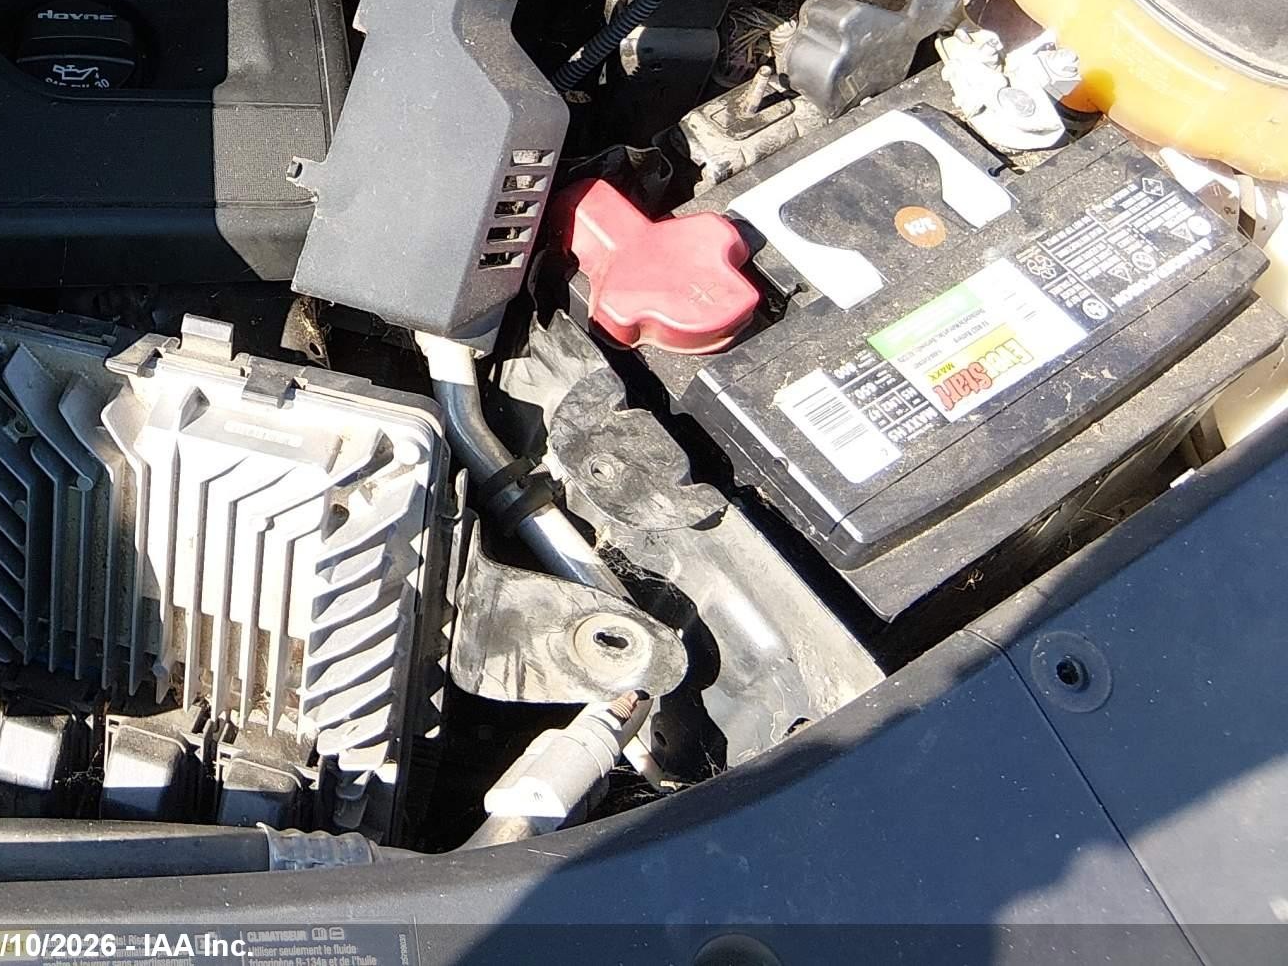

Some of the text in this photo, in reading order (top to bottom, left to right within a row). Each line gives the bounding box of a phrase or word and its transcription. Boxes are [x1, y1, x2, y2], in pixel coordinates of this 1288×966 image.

[929, 362, 956, 381] MAXX
[932, 337, 1034, 412] EverStart
[901, 406, 938, 433] MAXX
[886, 425, 908, 442] H5
